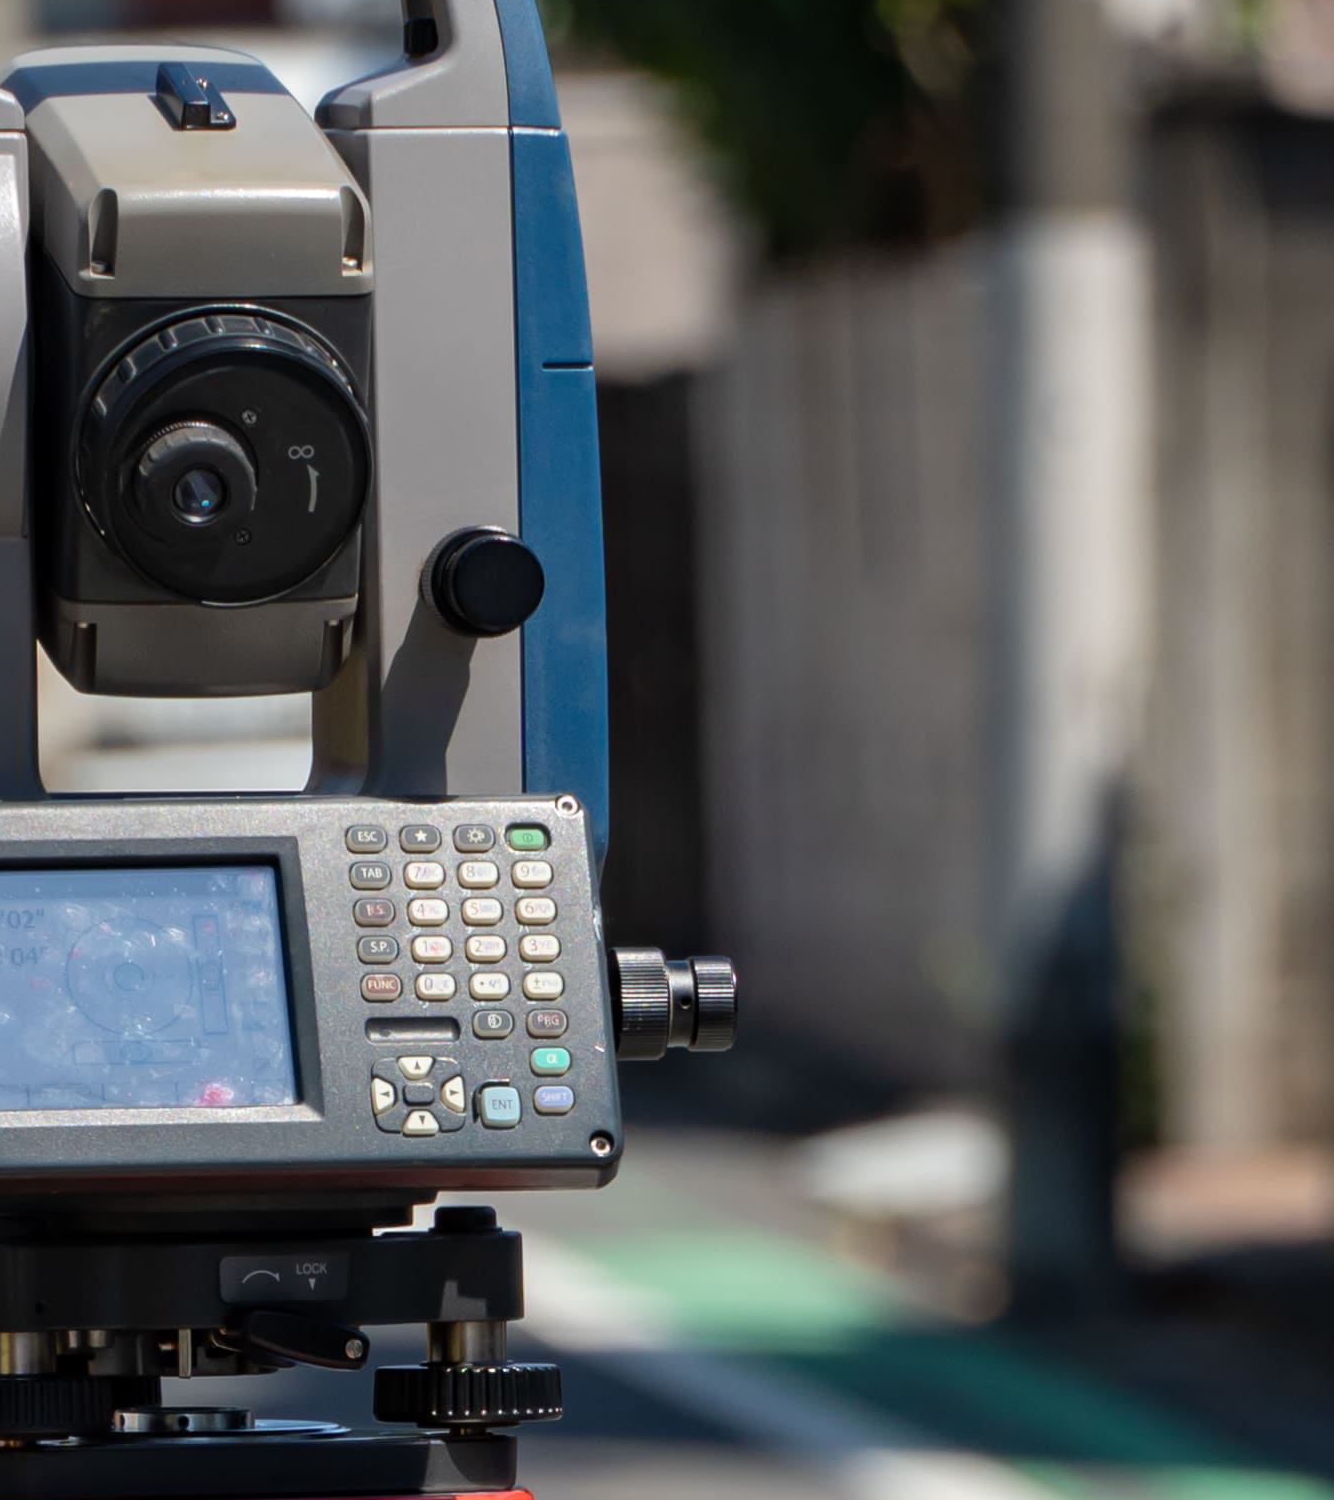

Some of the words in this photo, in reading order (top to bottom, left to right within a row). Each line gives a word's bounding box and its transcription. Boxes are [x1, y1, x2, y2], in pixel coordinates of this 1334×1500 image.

[358, 831, 378, 841] ESC
[361, 868, 382, 878] TAB
[413, 866, 420, 878] 7
[467, 866, 475, 877] 8
[520, 865, 529, 877] 9
[417, 903, 424, 916] 4
[471, 903, 478, 915] 5
[525, 902, 534, 914] 6
[371, 942, 390, 953] S.P.
[475, 940, 482, 952] 2
[530, 940, 537, 951] 3
[368, 980, 396, 990] FUNC
[424, 978, 433, 990] 0
[537, 1014, 560, 1027] PRG
[542, 1092, 567, 1101] SHIFT
[492, 1099, 514, 1110] ENT
[295, 1262, 327, 1275] LOCK
